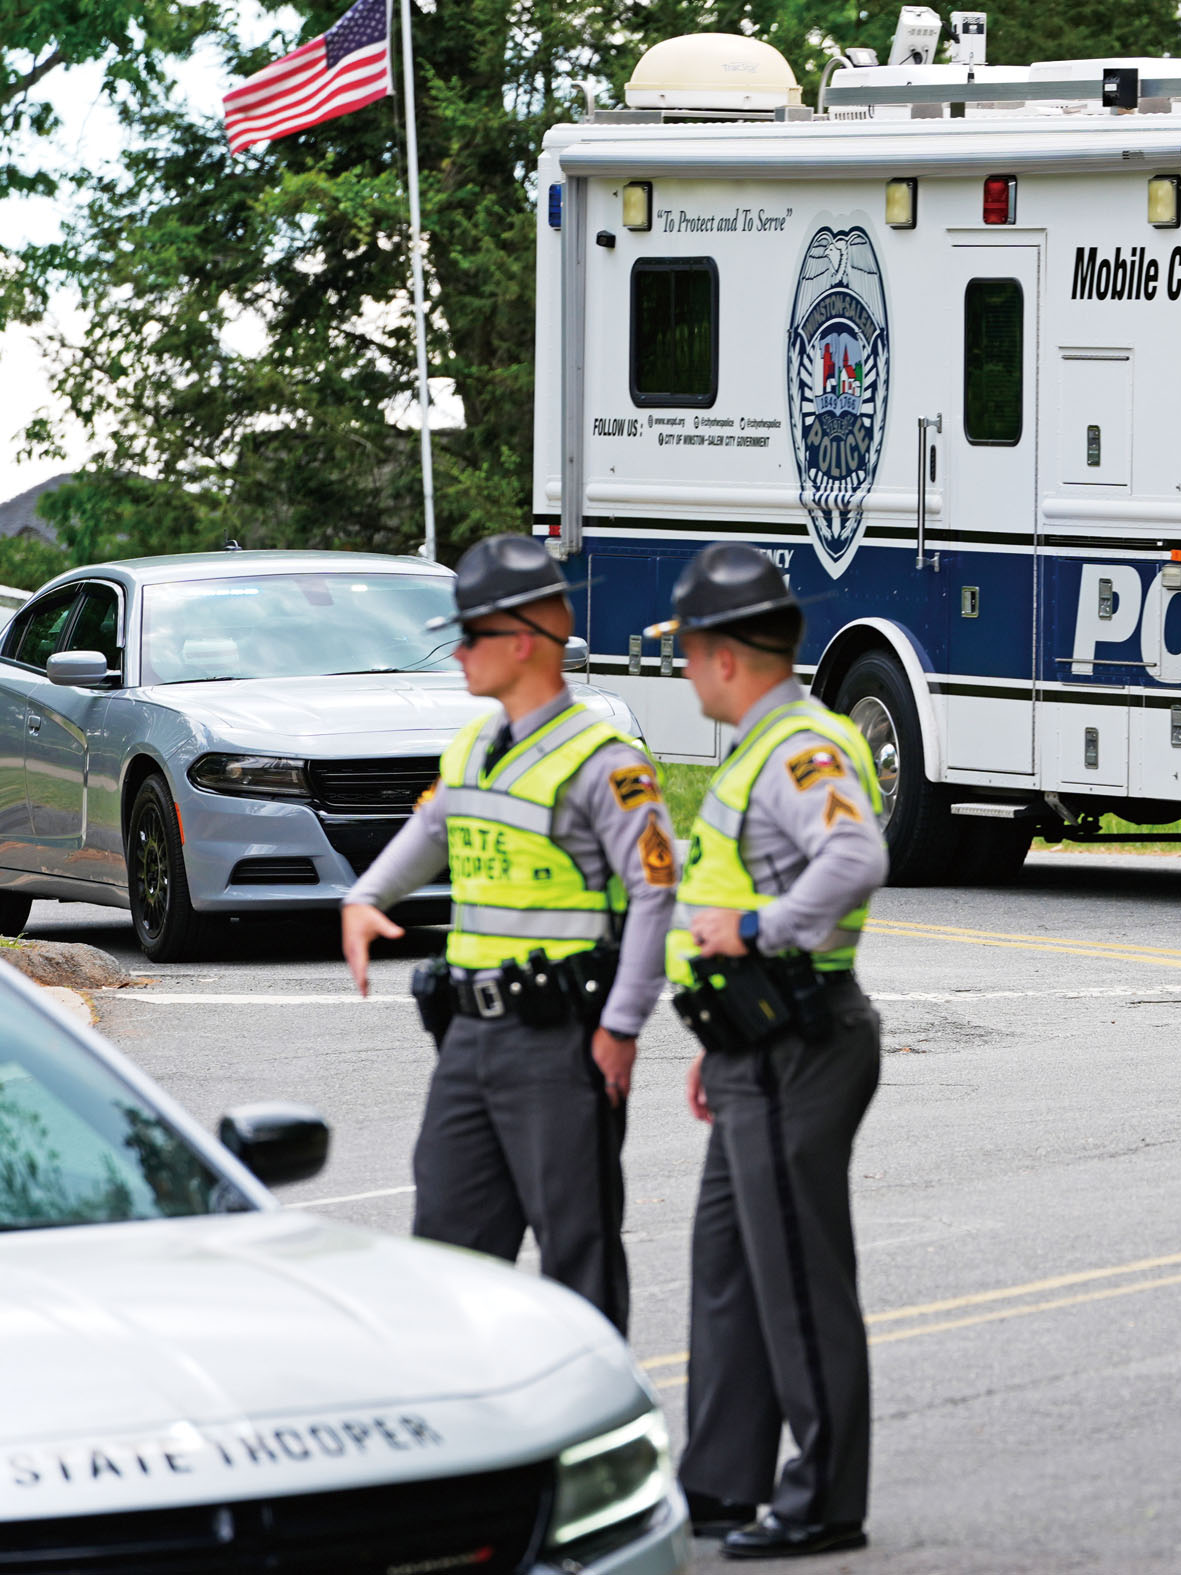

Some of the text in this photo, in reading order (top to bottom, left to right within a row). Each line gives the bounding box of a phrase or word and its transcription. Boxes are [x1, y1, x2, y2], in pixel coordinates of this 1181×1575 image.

[677, 210, 715, 233] Protect
[717, 208, 740, 232] and
[742, 209, 753, 232] To
[1071, 245, 1158, 301] Mobile
[803, 294, 876, 342] WINSTON-SALEM
[593, 418, 625, 436] FOLLOW
[627, 418, 639, 437] US
[665, 433, 770, 447] CITY OF WINSTON-SALEM CITY GOVERNMENT
[807, 417, 871, 477] POLICE
[10, 1413, 446, 1488] STATE TROOPER
